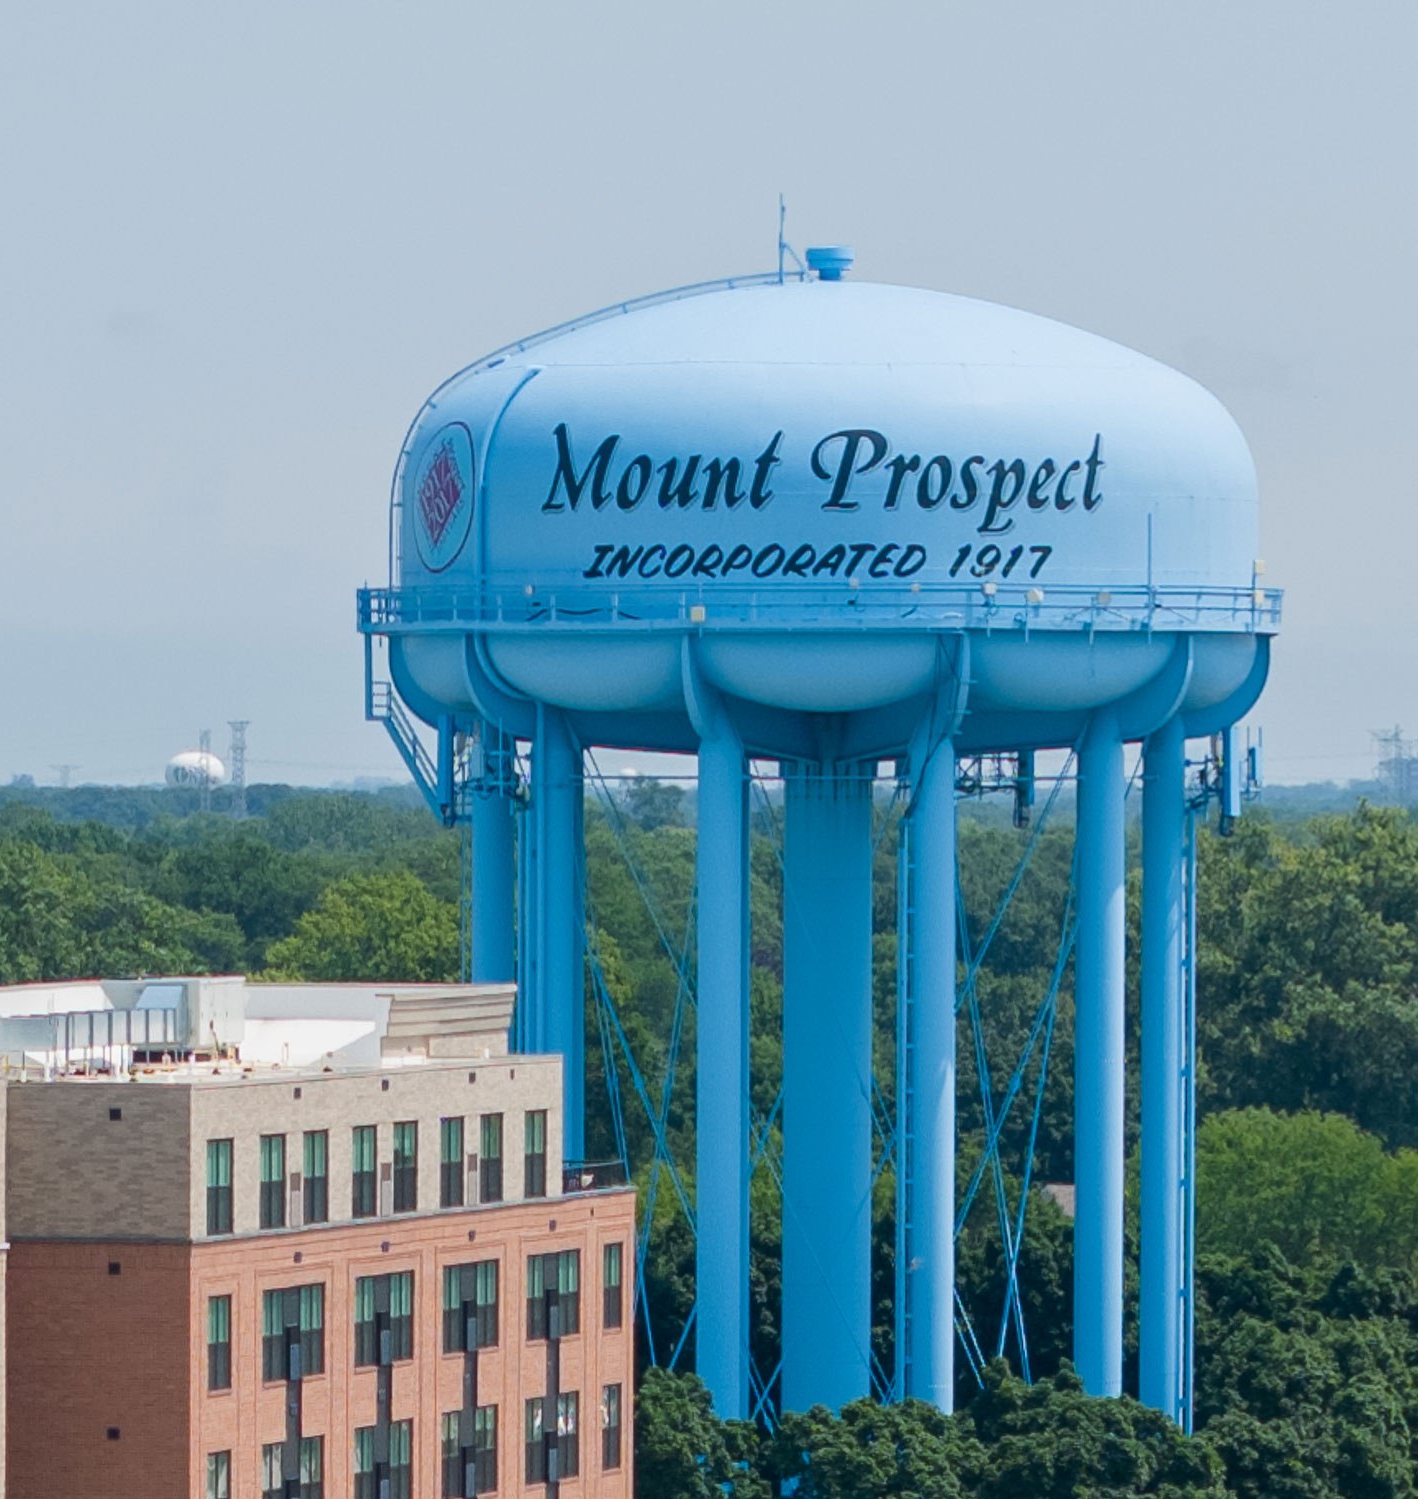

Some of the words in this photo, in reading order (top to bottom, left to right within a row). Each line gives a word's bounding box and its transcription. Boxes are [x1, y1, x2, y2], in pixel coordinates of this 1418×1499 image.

[541, 423, 784, 511] Mount
[811, 429, 1105, 534] Prospect
[582, 543, 927, 578] INCORPORATED
[949, 543, 1053, 578] 1917
